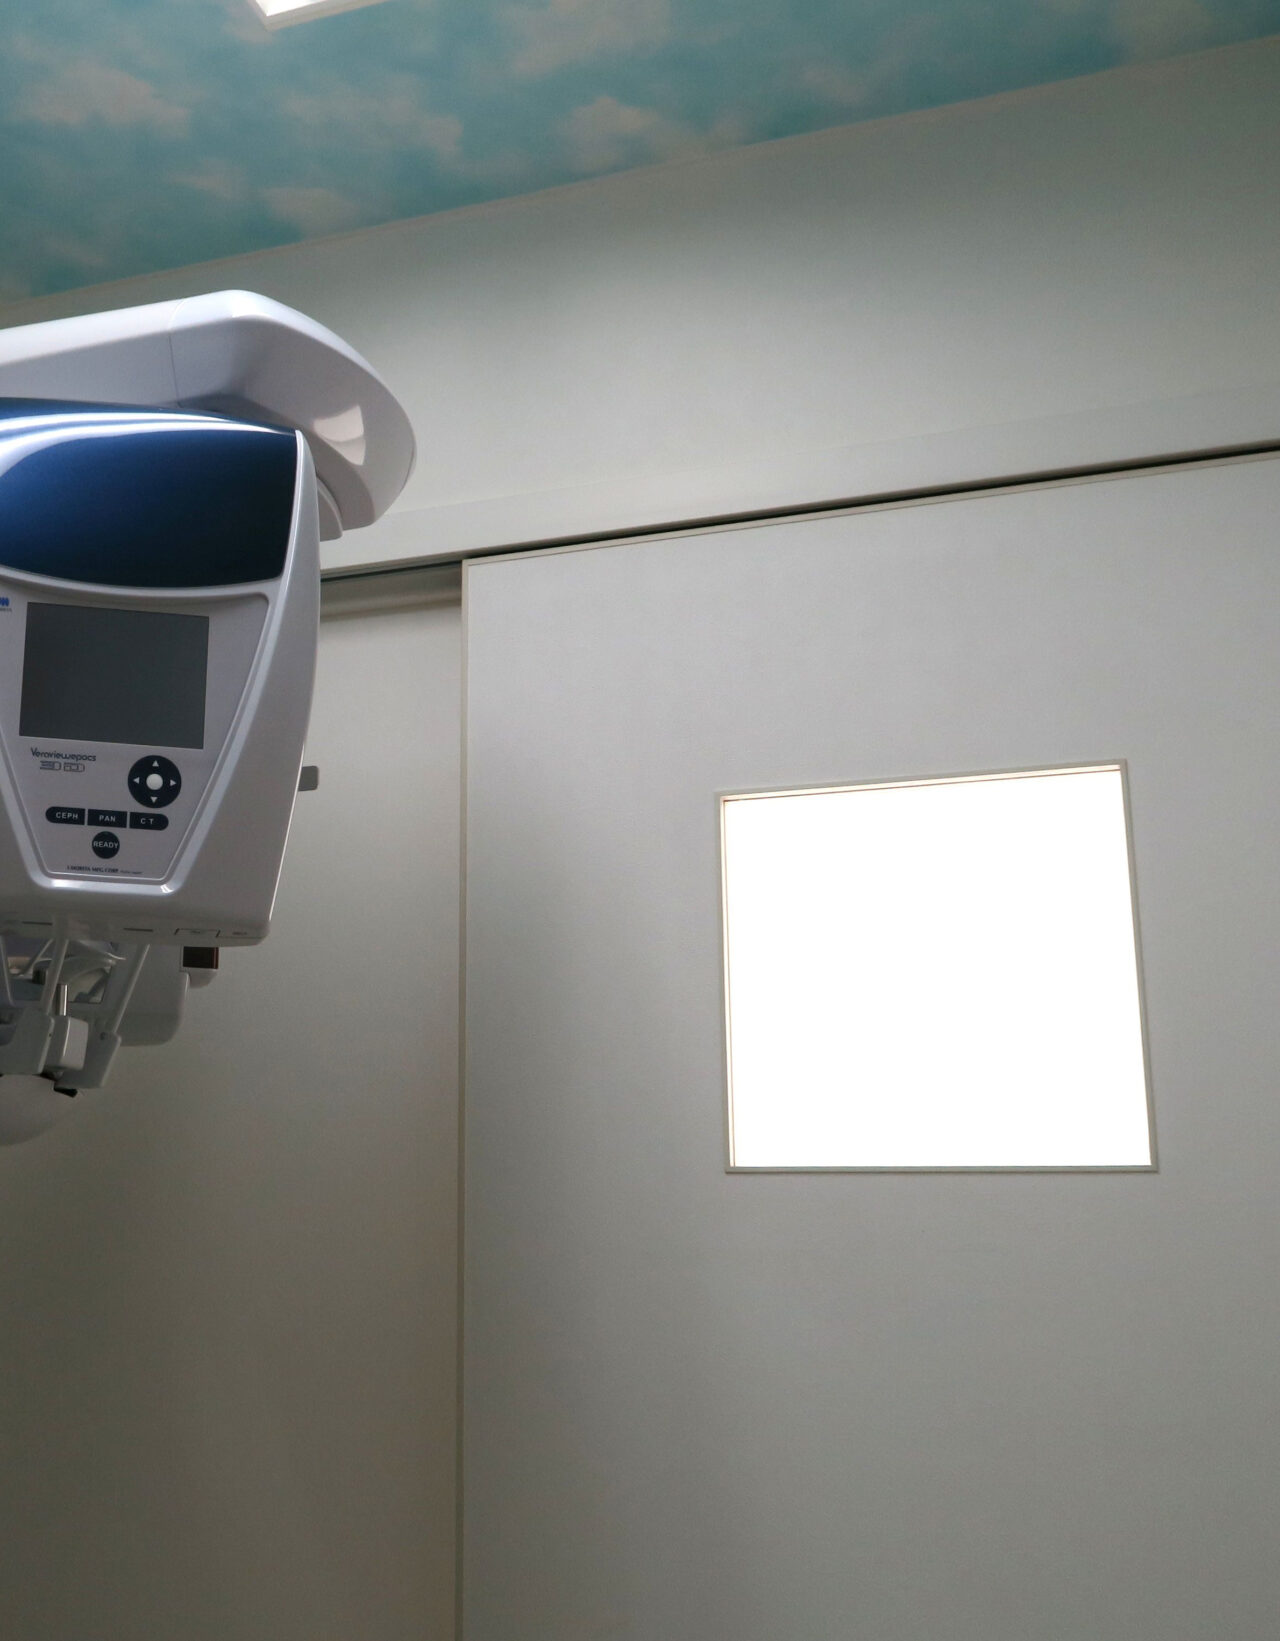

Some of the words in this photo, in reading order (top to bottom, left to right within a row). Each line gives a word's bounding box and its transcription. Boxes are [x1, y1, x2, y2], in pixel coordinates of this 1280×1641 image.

[30, 747, 96, 762] Veraviewepocs
[55, 811, 79, 820] CEPH
[98, 814, 116, 822] PAN
[93, 841, 119, 849] READY
